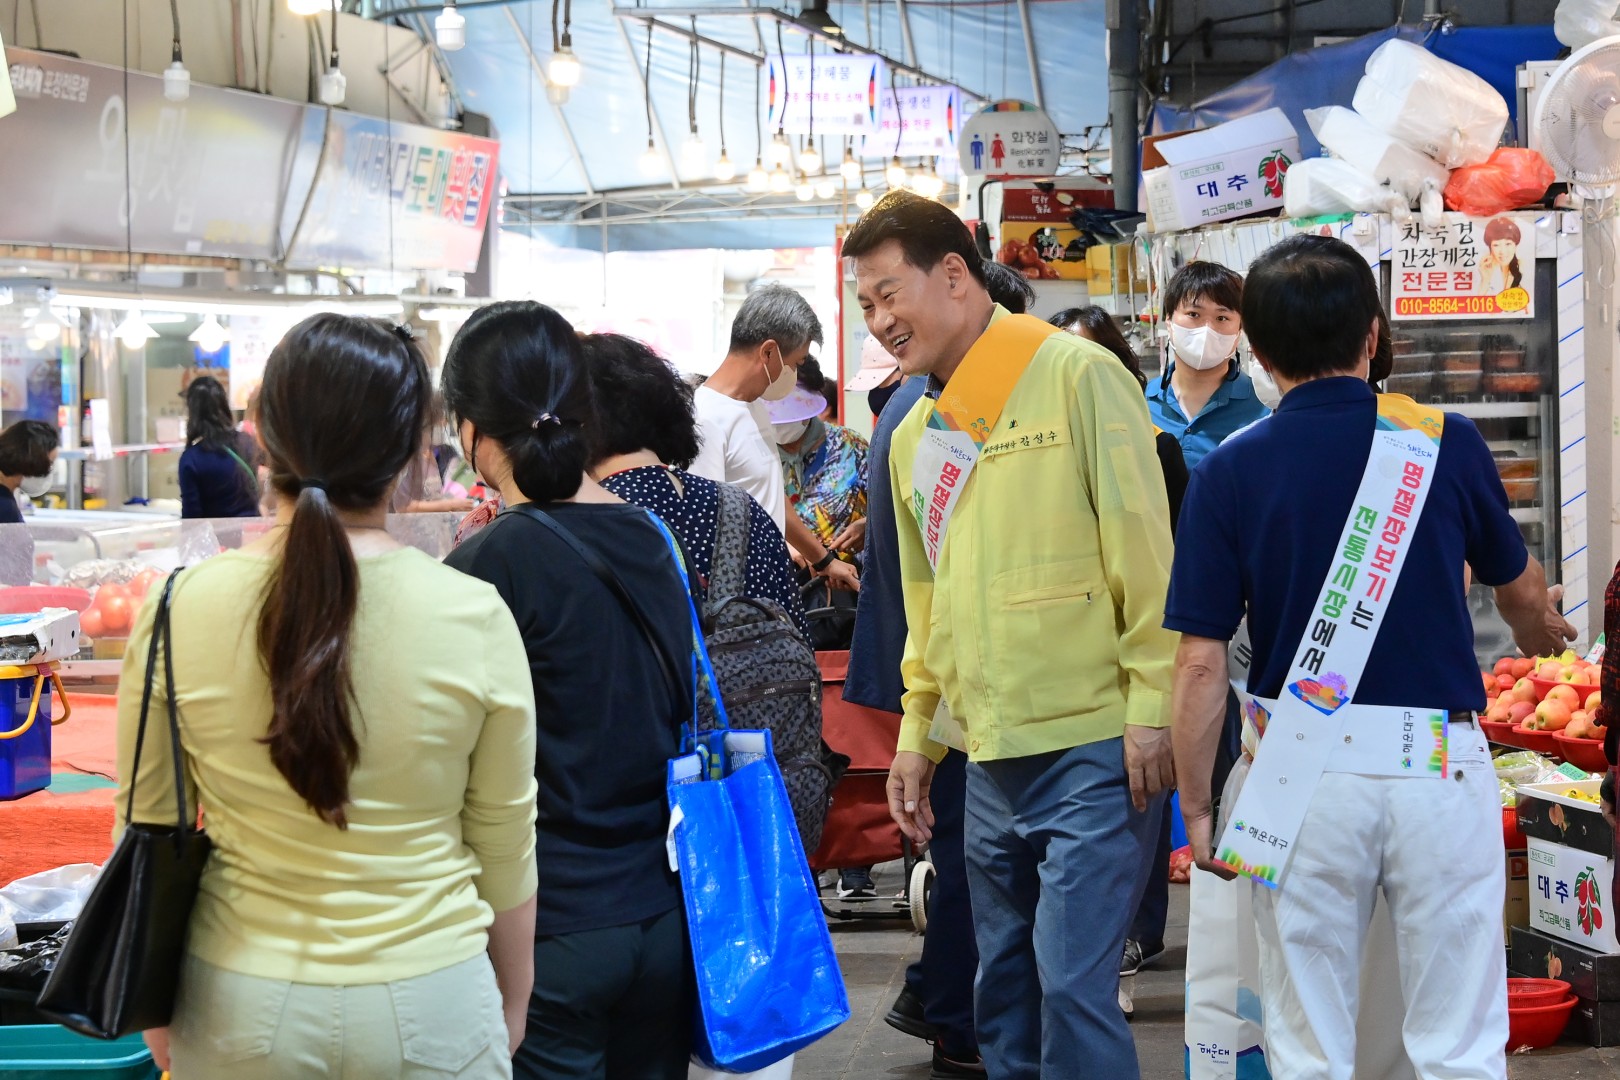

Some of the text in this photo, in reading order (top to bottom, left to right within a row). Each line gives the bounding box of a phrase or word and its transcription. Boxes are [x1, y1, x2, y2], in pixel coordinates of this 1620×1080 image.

[1011, 130, 1049, 145] 화장실
[1196, 174, 1249, 198] 대추
[1399, 247, 1478, 269] 간장게장
[1402, 271, 1473, 292] 전문점
[1400, 297, 1494, 314] 010-8564-1016
[1298, 505, 1379, 676] 전통시장에서
[1248, 826, 1289, 850] 해운대구
[1537, 874, 1569, 904] 대추
